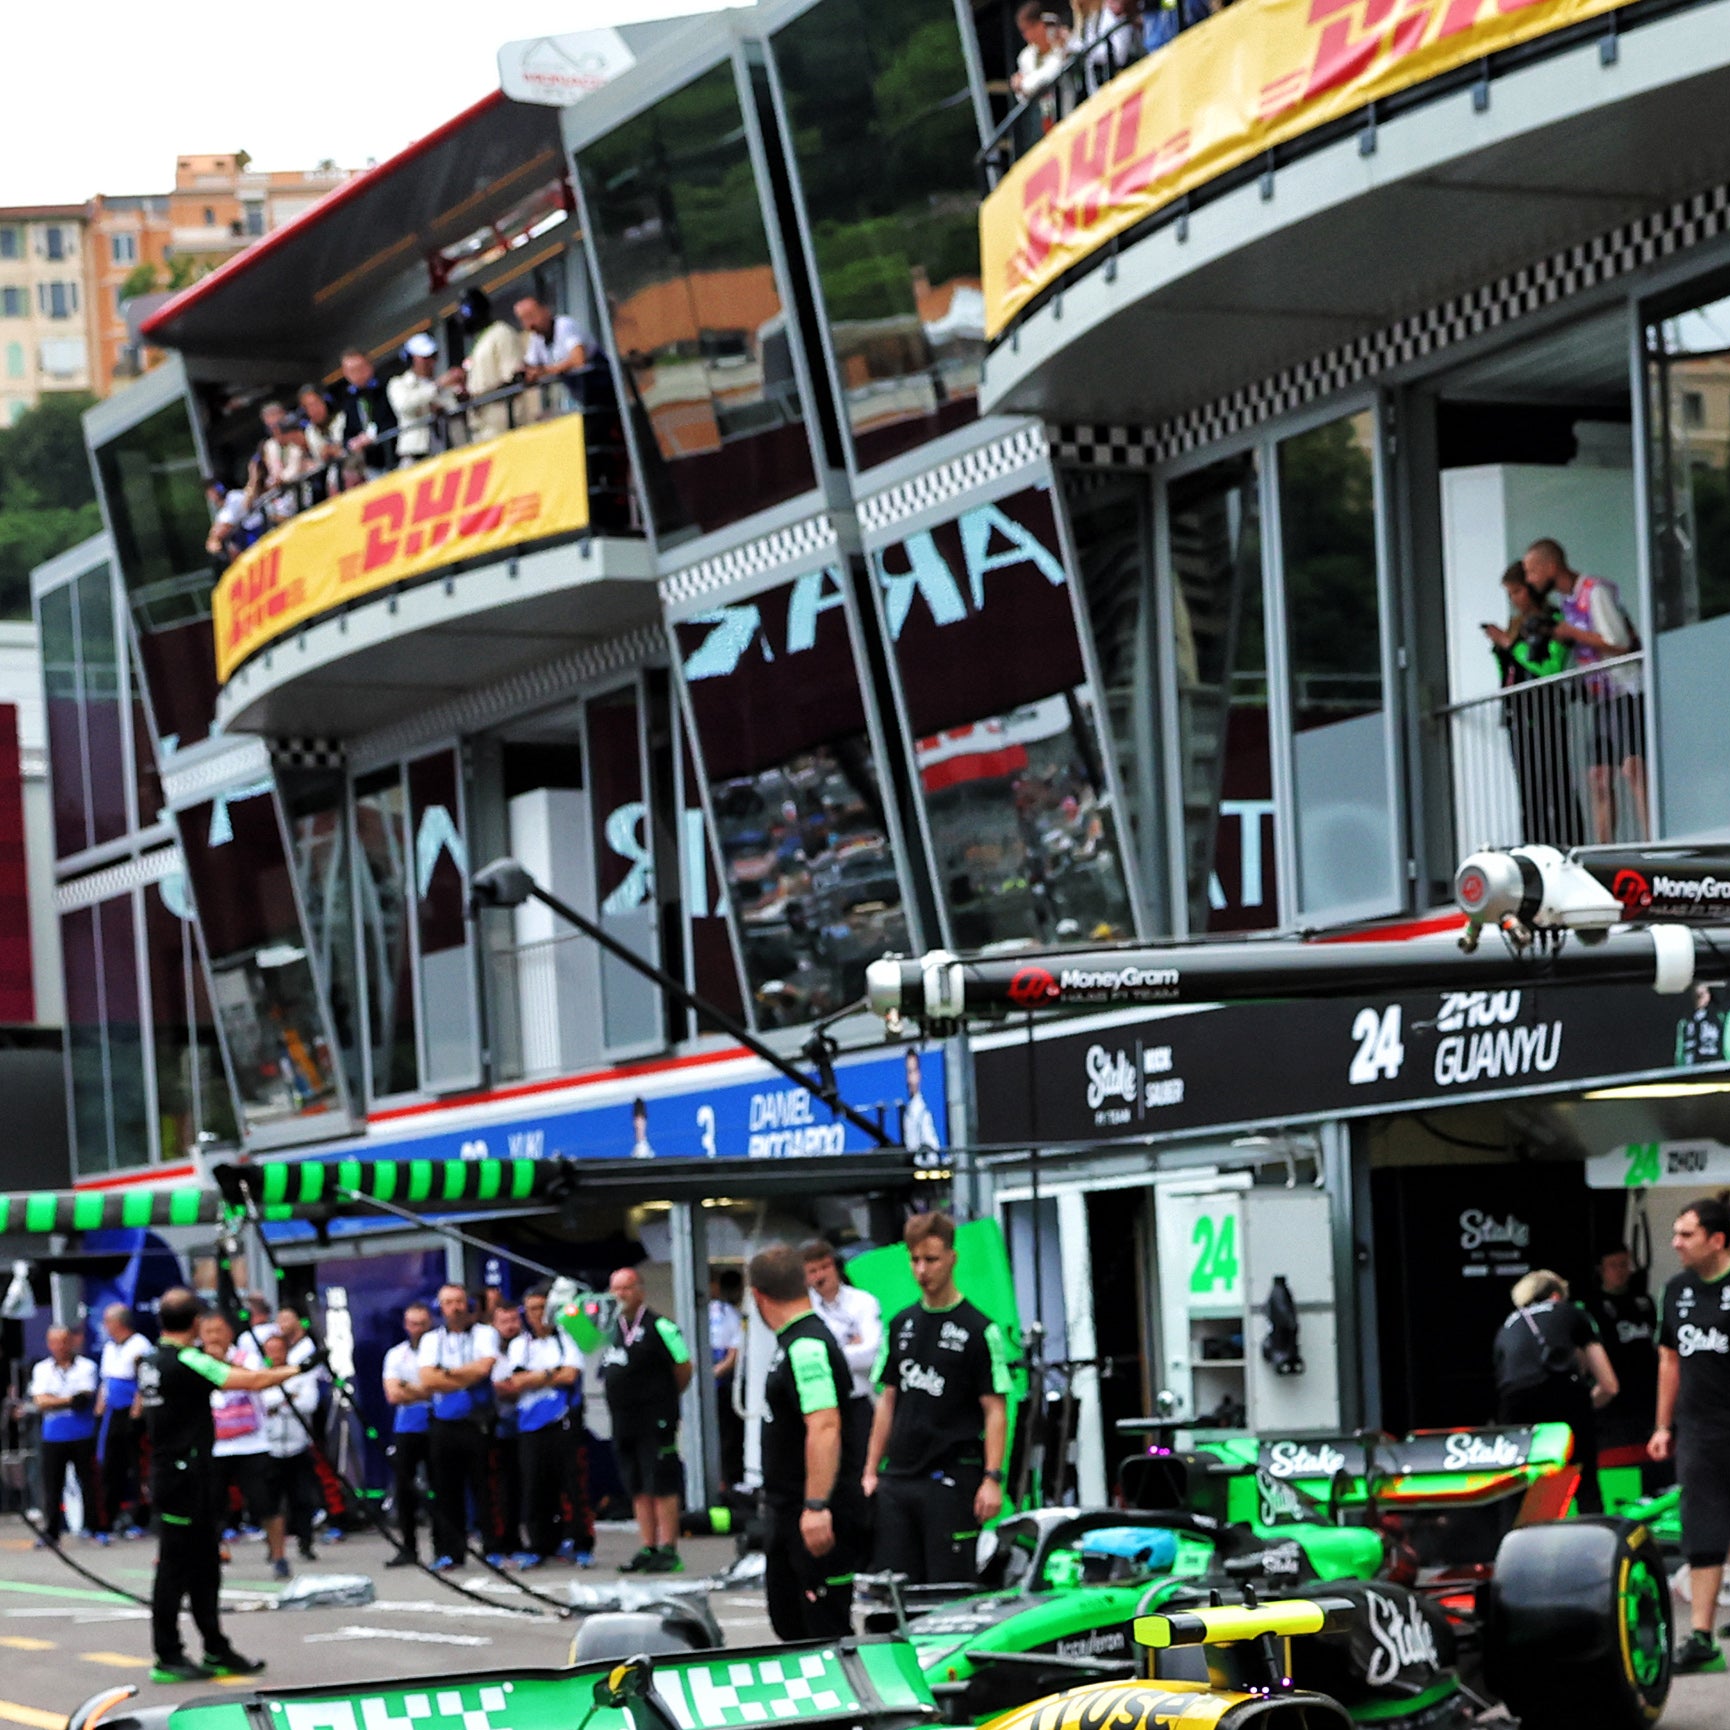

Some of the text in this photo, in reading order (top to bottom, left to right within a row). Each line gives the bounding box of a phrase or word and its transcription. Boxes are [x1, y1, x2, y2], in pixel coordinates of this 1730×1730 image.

[361, 459, 504, 572] DHL
[1060, 967, 1180, 990] MoneyGram
[1349, 1004, 1404, 1084] 24
[1434, 1020, 1562, 1086] GUANYU
[1624, 1142, 1662, 1186] 24
[1190, 1213, 1238, 1292] 24
[1677, 1324, 1730, 1357] Stake
[1268, 1441, 1345, 1477] Stake
[1444, 1433, 1520, 1470] Stake
